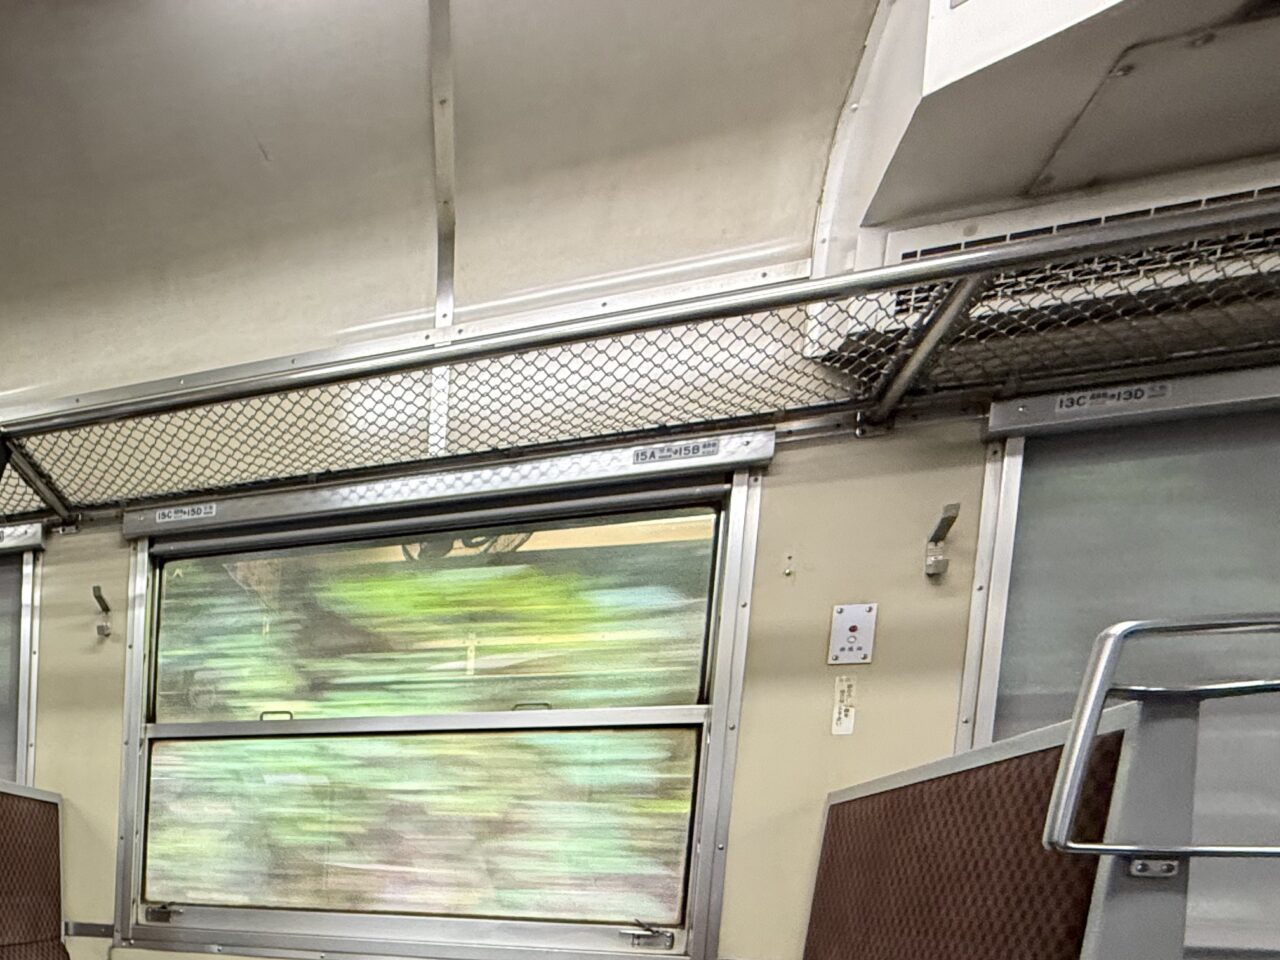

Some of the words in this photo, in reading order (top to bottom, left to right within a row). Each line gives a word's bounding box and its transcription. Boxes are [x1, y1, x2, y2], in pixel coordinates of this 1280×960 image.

[1058, 395, 1087, 408] 13C
[1116, 388, 1145, 401] 13D
[635, 451, 656, 461] 15A
[679, 445, 700, 456] 15B
